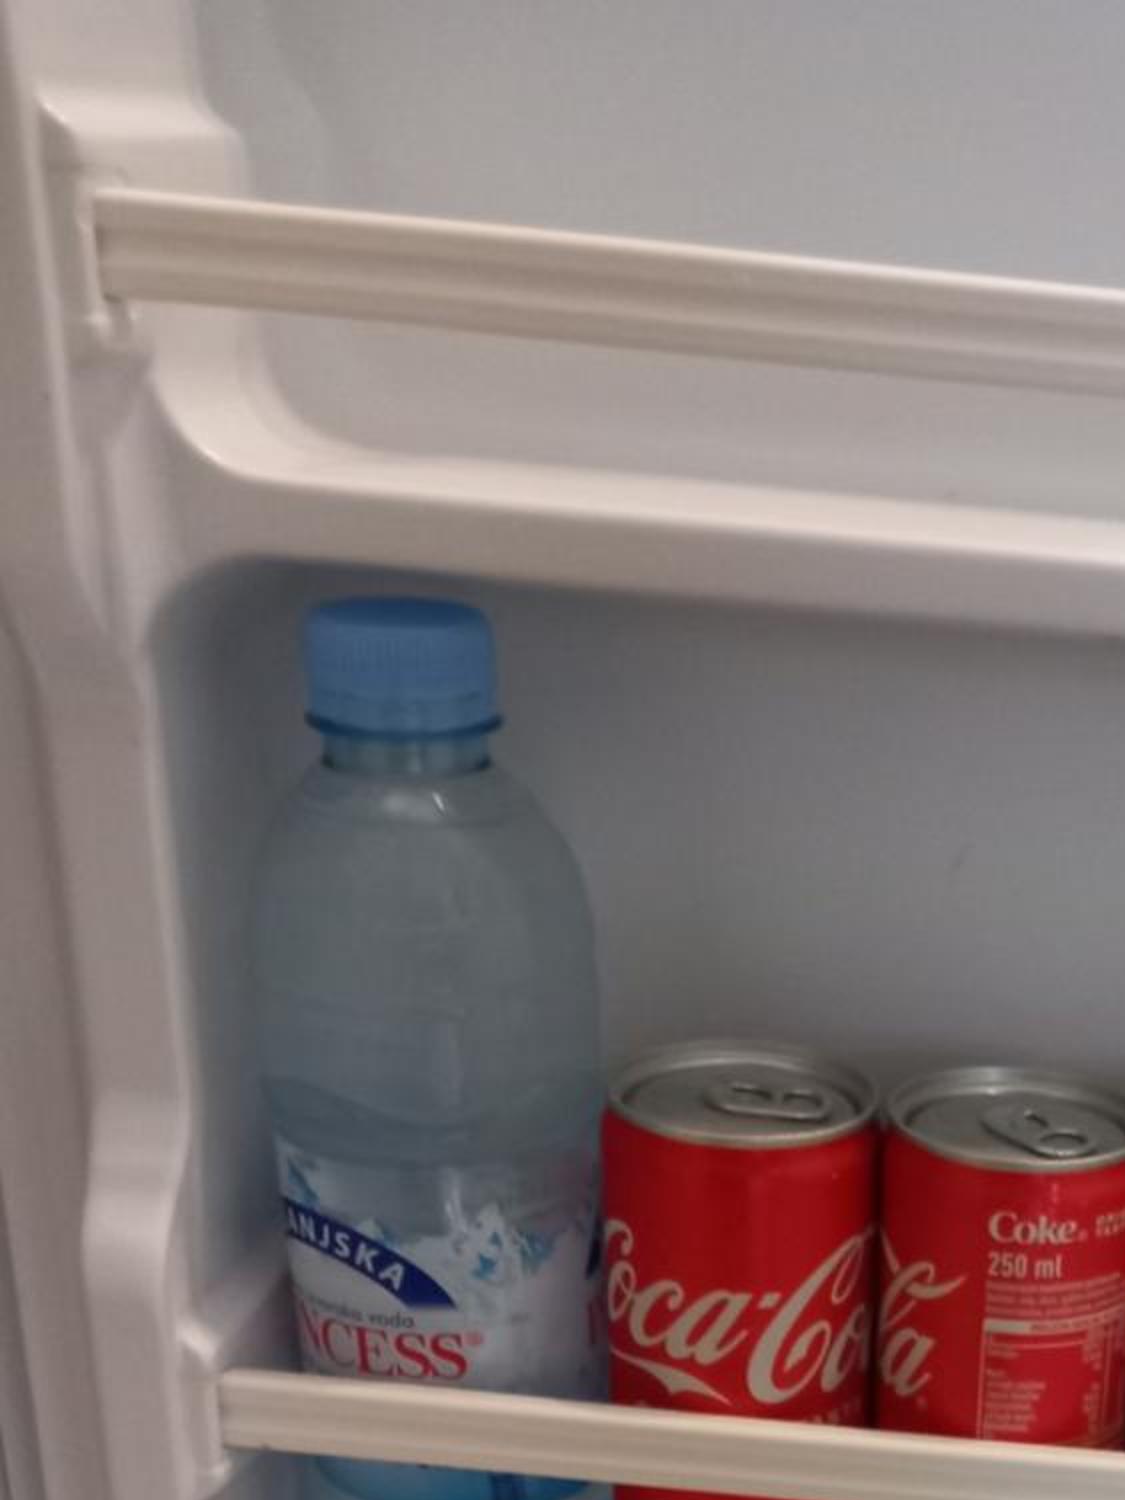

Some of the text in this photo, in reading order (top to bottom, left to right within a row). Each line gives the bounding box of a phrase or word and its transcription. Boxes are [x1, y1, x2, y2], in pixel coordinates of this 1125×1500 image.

[987, 1210, 1078, 1245] Coke
[987, 1251, 1063, 1279] 250 ml
